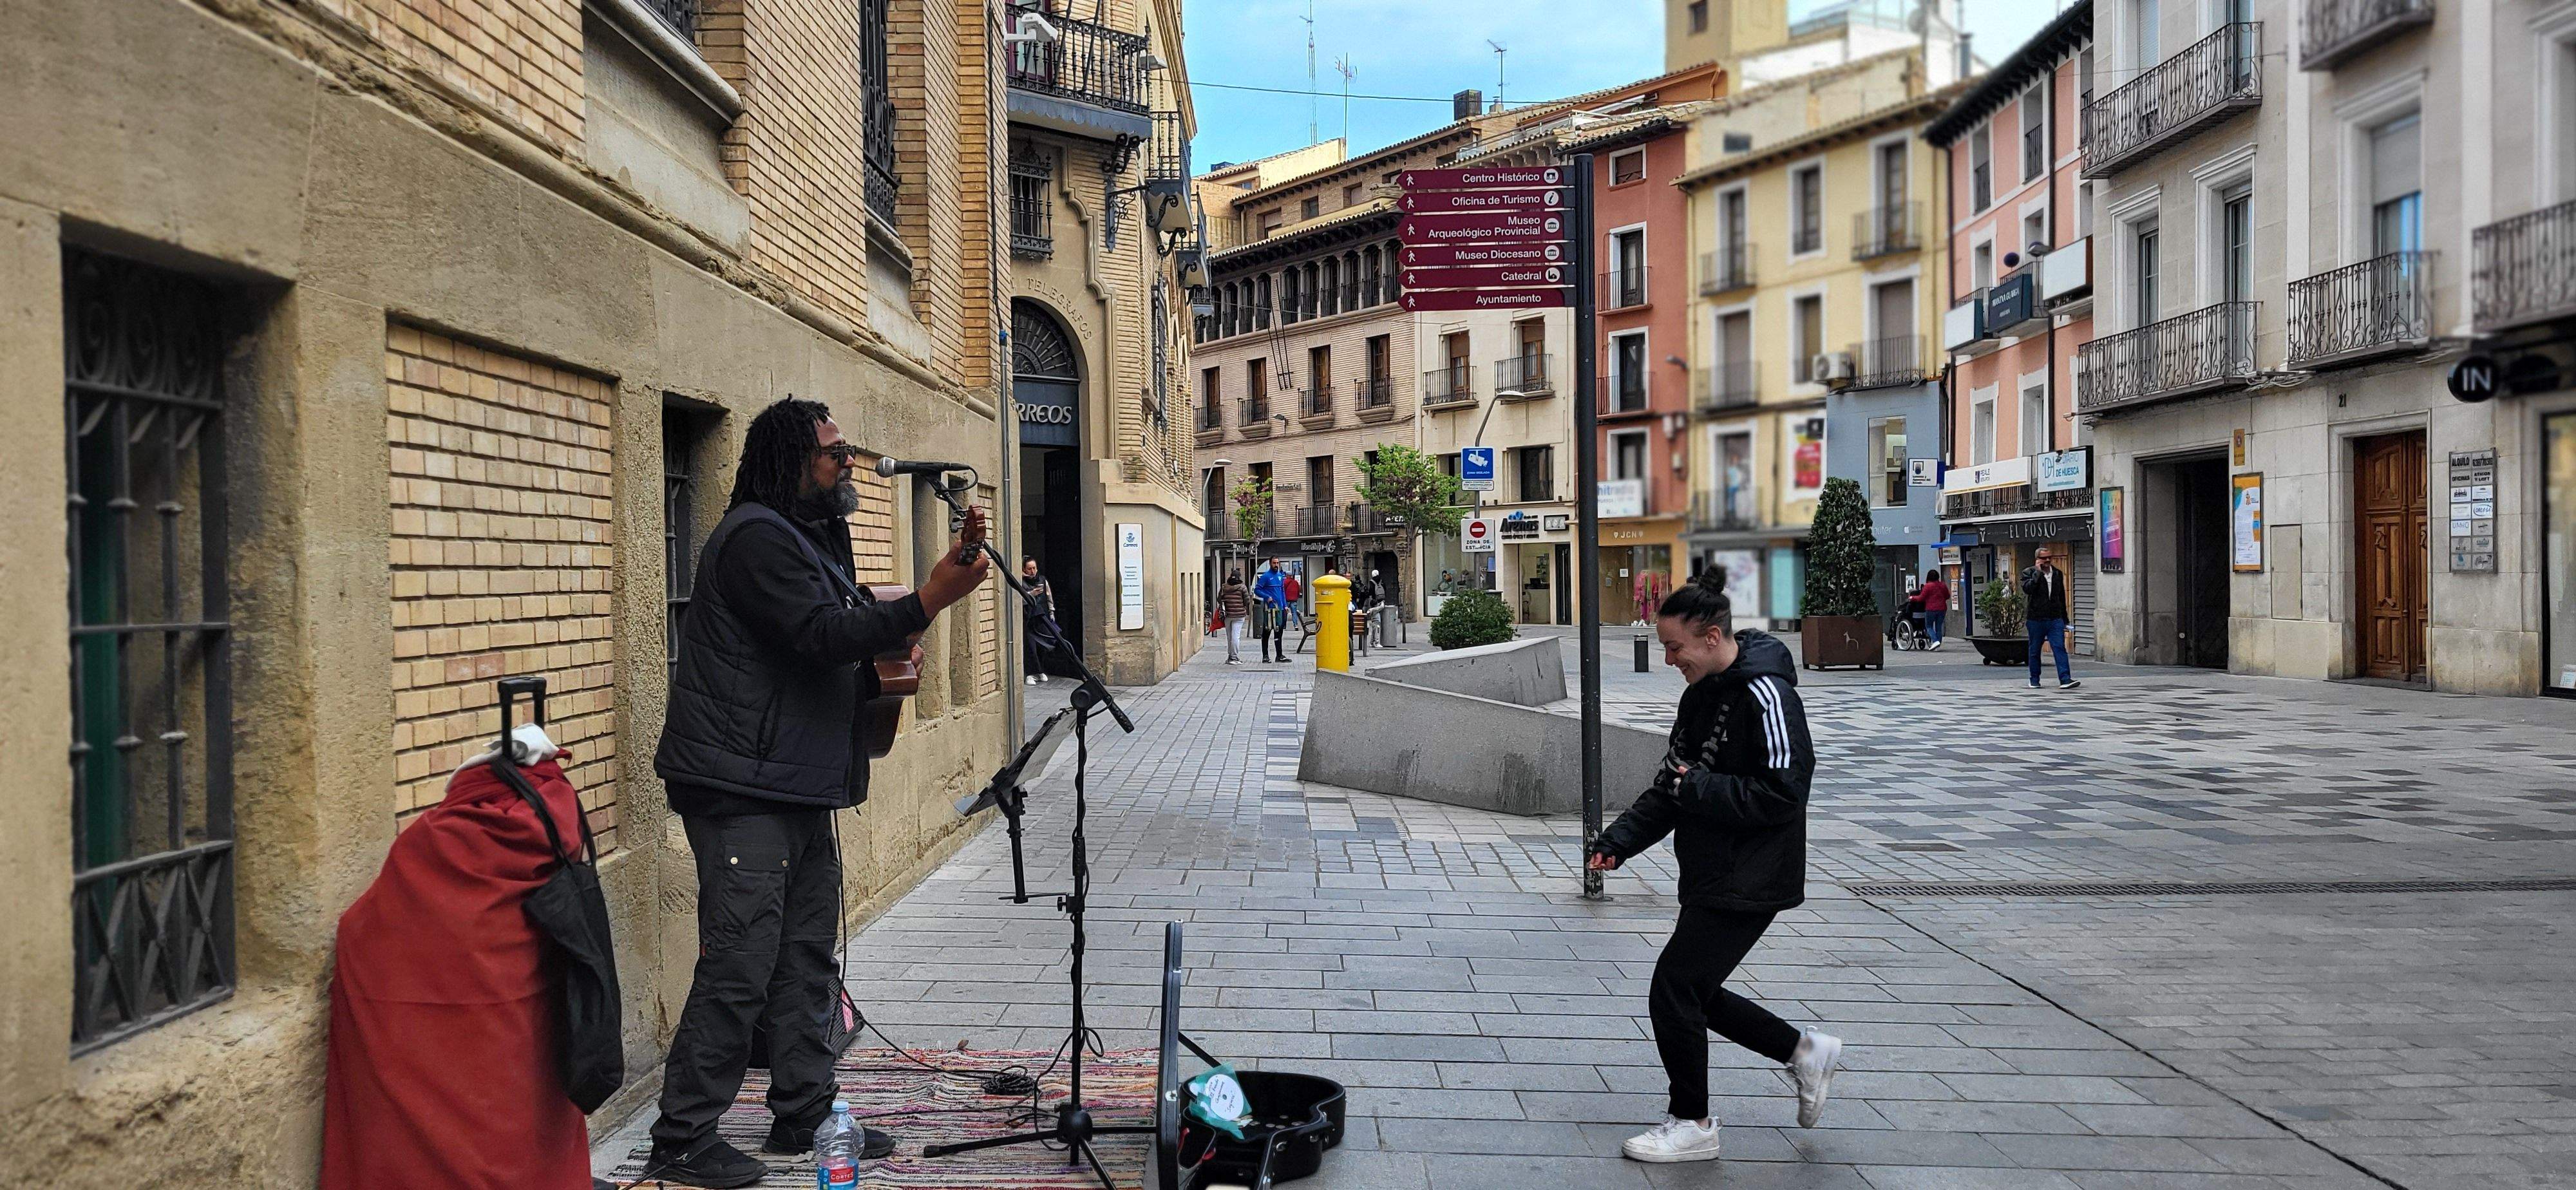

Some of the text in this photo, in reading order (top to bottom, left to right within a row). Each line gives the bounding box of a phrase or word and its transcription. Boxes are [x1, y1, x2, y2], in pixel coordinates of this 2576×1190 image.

[1462, 172, 1540, 183] Centro Histórico
[1452, 194, 1540, 207] Oficina de Turismo
[1508, 216, 1540, 225] Museo
[1428, 226, 1540, 239] Arqueológico Provincial
[1455, 250, 1541, 261] Museo Diocesano
[1501, 271, 1542, 281] Catedral
[1475, 294, 1542, 305] Ayuntamiento
[1027, 278, 1092, 340] TELEGRAFOS
[2462, 366, 2491, 392] IN
[2338, 393, 2347, 408] 21
[1016, 402, 1072, 424] RREOS
[1499, 518, 1539, 533] Arenas
[2009, 524, 2020, 538] EL
